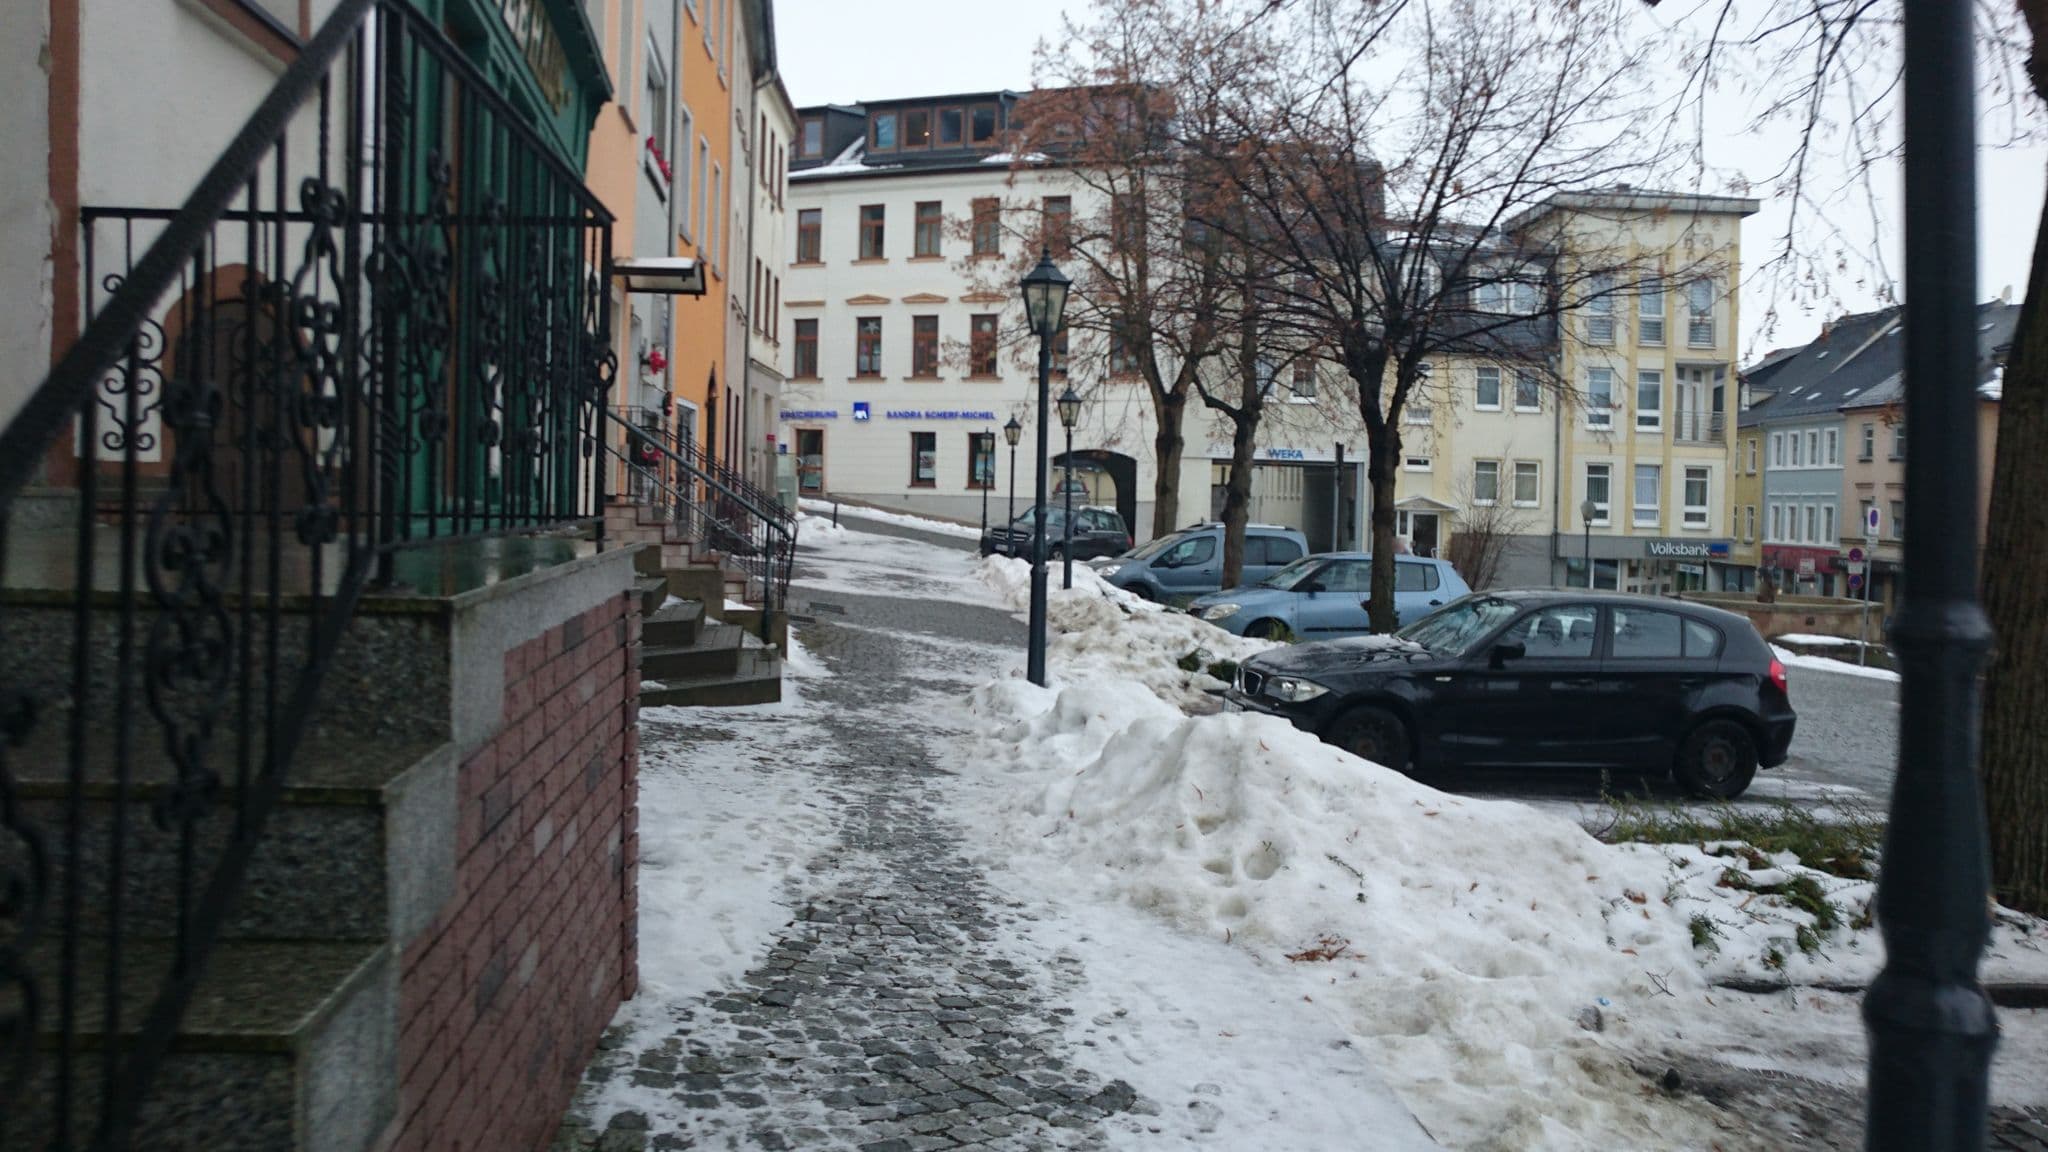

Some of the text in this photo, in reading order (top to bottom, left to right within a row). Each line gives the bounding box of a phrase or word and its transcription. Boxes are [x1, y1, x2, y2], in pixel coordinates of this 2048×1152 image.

[886, 410, 922, 420] SANDRA
[1267, 448, 1304, 459] WEKA
[1650, 542, 1710, 556] Volksbank
